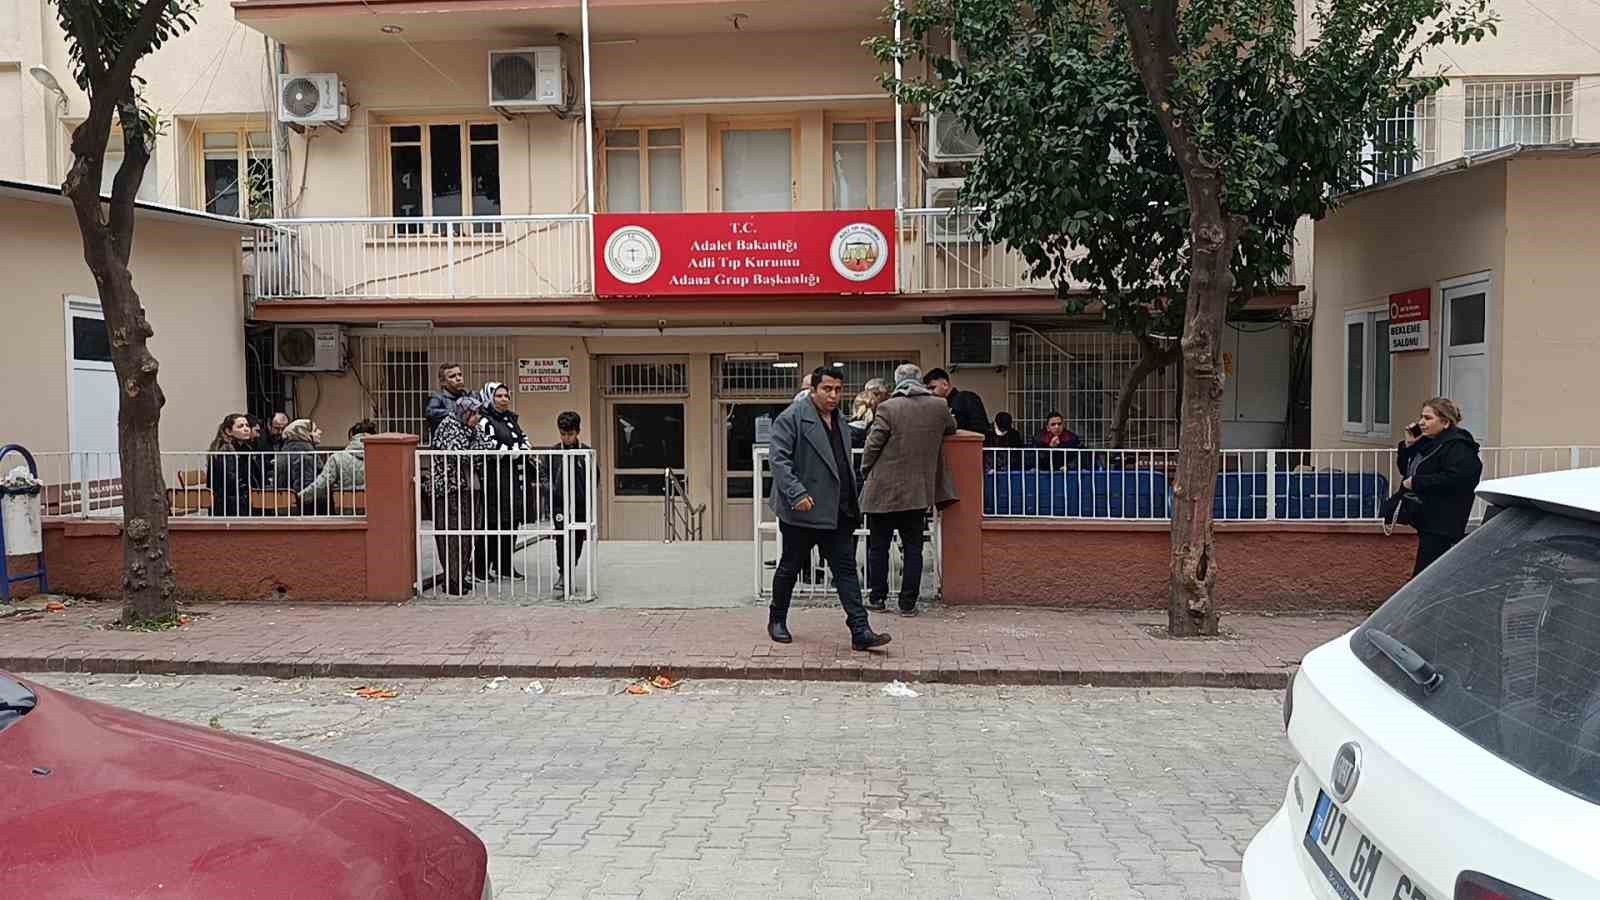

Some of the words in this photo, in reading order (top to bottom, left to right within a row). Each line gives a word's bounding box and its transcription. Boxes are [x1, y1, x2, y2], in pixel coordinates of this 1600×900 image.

[729, 222, 757, 234] T.C.
[690, 239, 732, 251] Adalet
[736, 239, 798, 253] Bakanlığı
[688, 256, 715, 268] Adli
[718, 257, 741, 270] Tıp
[744, 256, 800, 268] Kurumu
[669, 274, 711, 286] Adana
[714, 273, 749, 287] Grup
[753, 273, 821, 287] Başkanlığı
[1390, 323, 1421, 336] BEKLEME
[1393, 336, 1420, 348] SALONU
[1320, 802, 1347, 857] 01
[1349, 833, 1384, 899] GM
